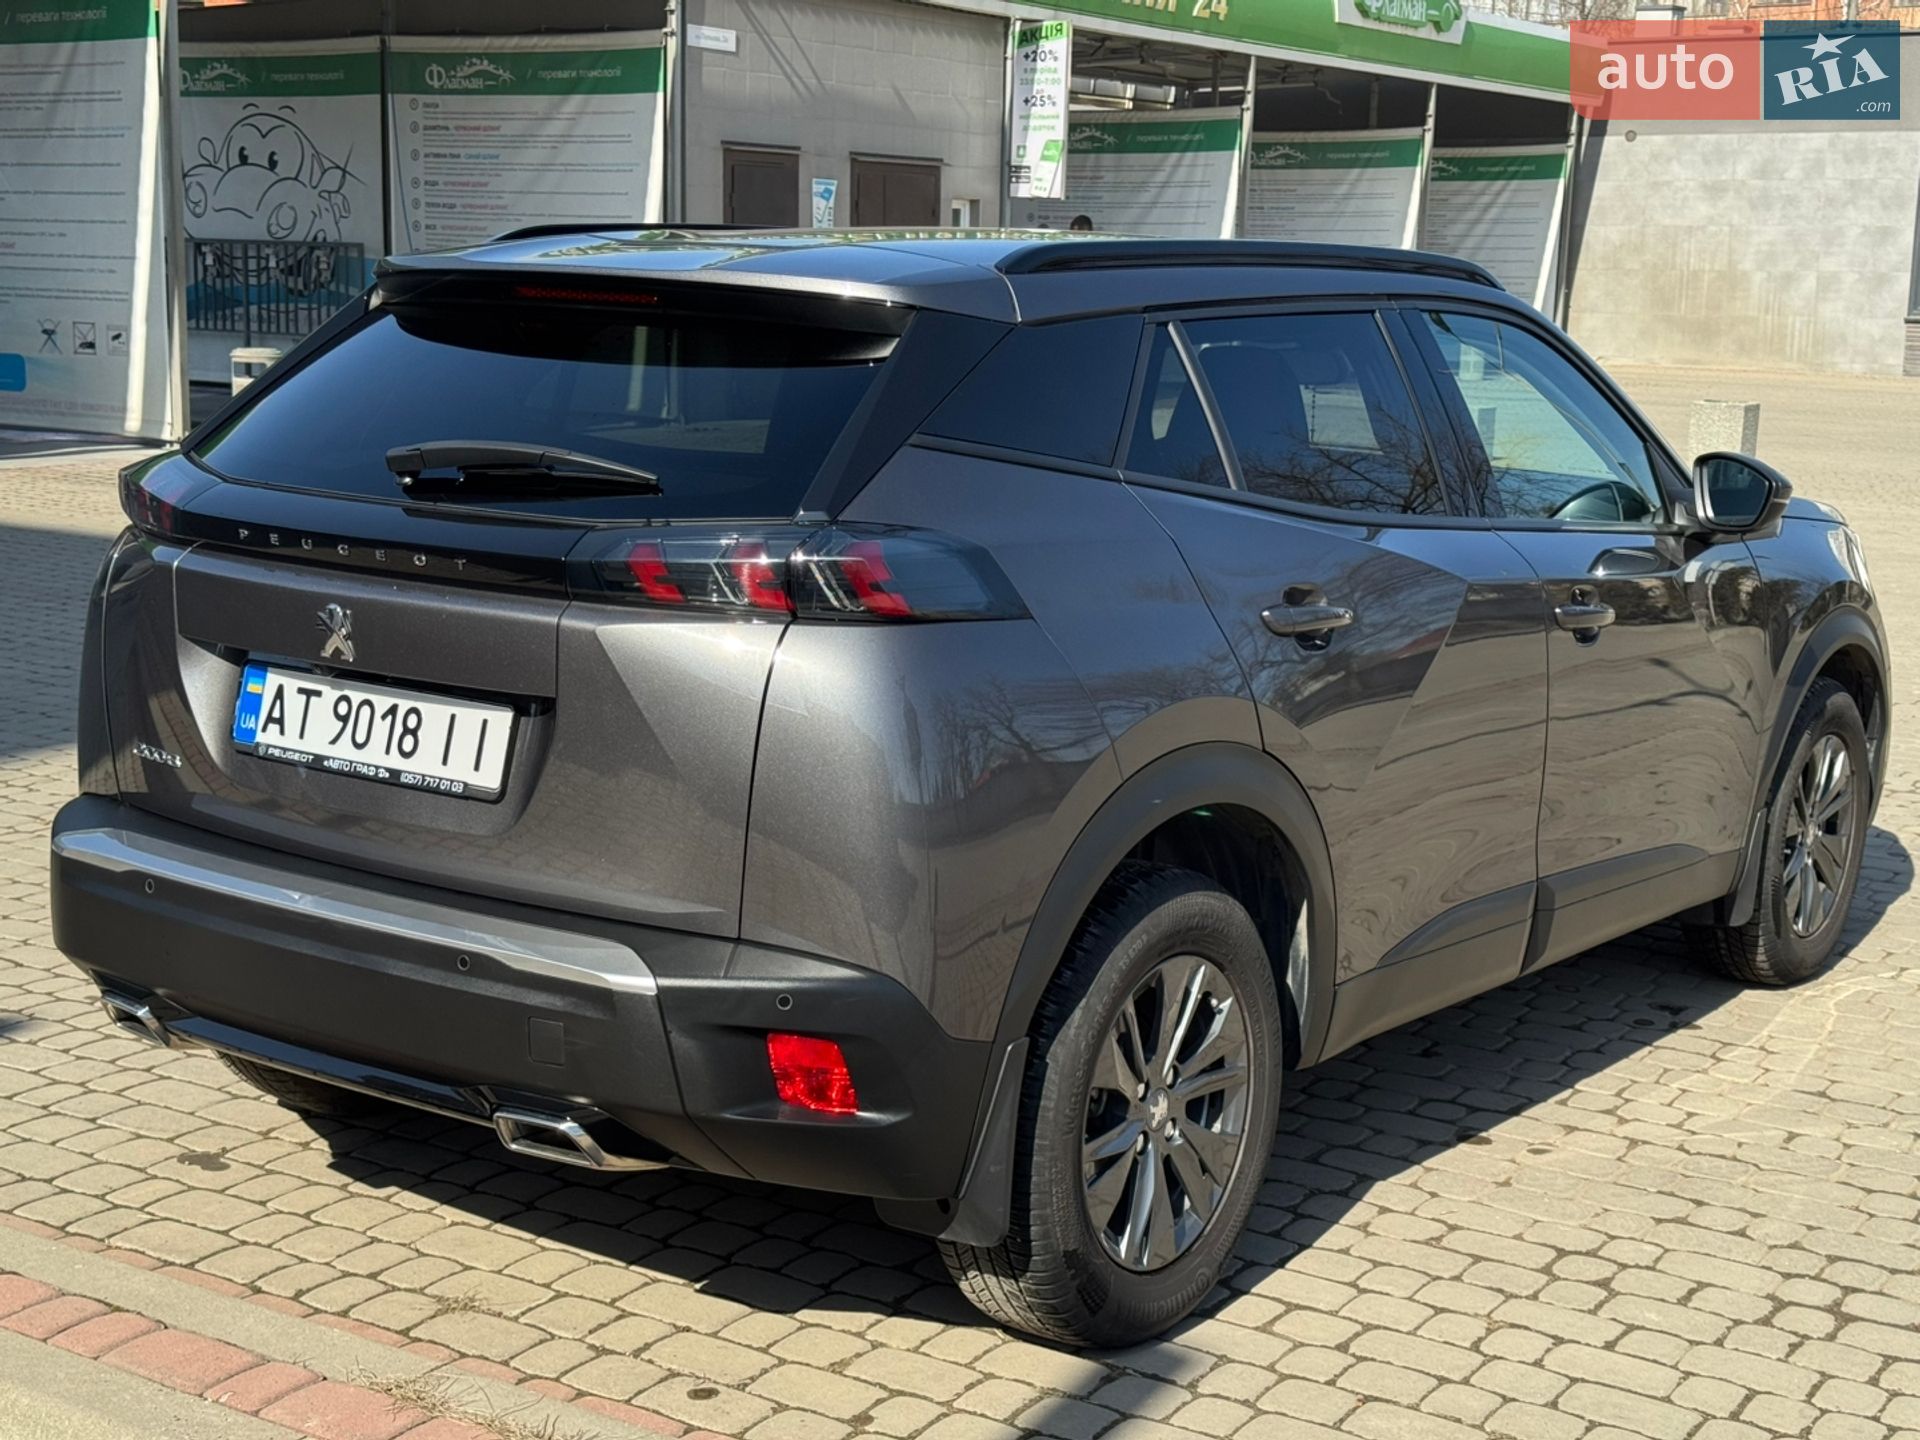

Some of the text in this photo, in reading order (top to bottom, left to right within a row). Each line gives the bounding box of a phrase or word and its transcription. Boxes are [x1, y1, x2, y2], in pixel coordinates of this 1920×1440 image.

[16, 12, 60, 25] переваги
[1019, 22, 1063, 46] АКЦІЯ
[1023, 48, 1058, 62] +20%
[425, 63, 483, 90] Флагман
[1023, 94, 1057, 107] +25%
[239, 528, 466, 571] PEUGEOT
[240, 713, 256, 731] UA
[261, 683, 322, 740] AT
[328, 693, 422, 760] 9018
[268, 747, 314, 763] PEUGEOT
[400, 771, 464, 793] (057) 717 01 03
